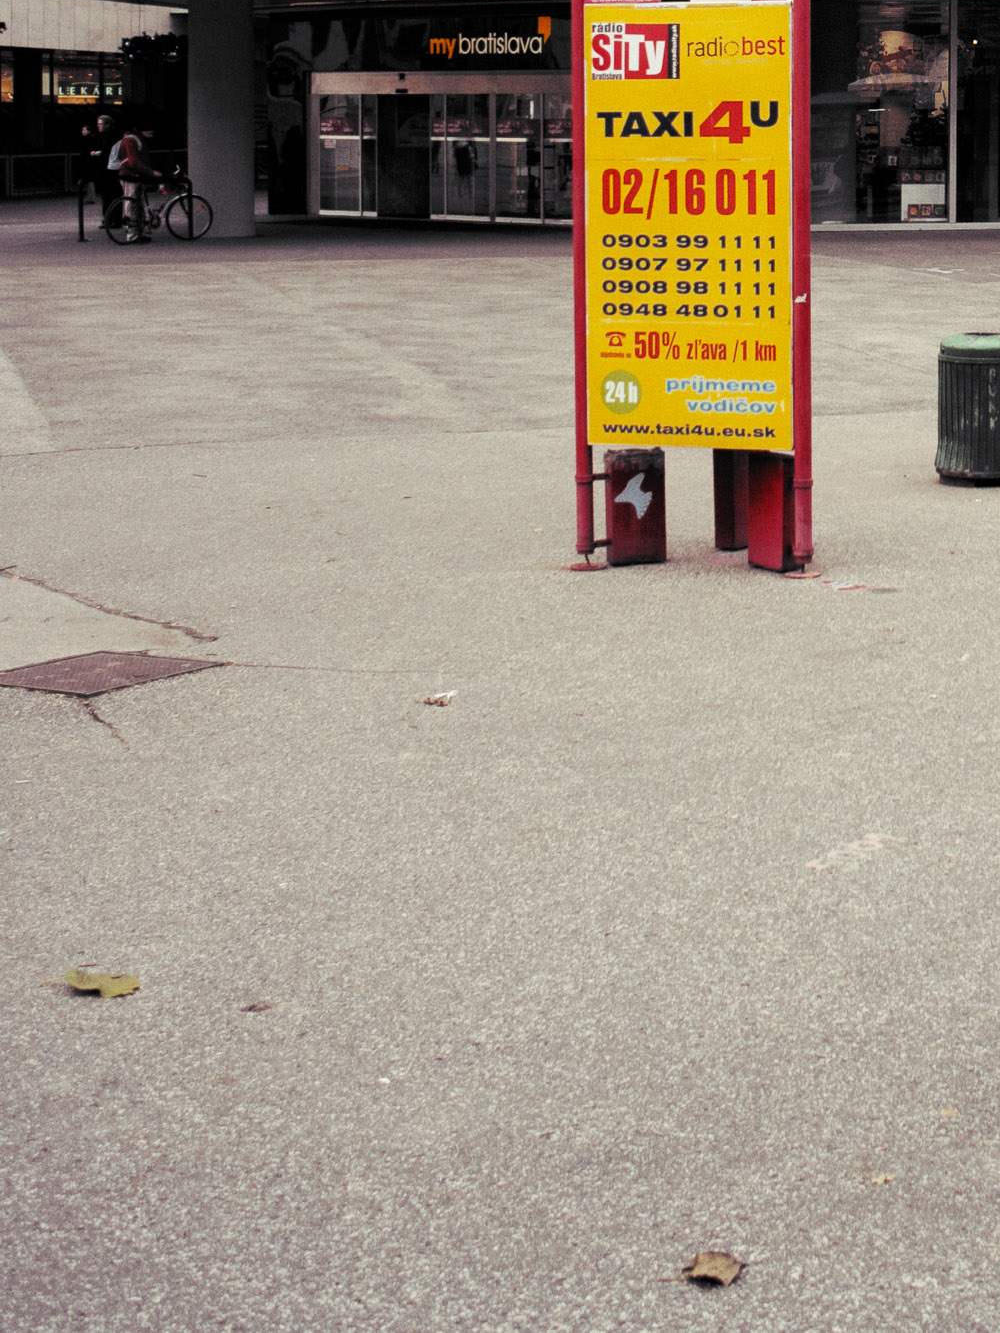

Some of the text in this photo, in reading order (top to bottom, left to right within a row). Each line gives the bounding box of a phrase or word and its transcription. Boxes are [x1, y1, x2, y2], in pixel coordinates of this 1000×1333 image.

[430, 32, 542, 59] my bratislava
[602, 168, 775, 220] 02/16 011
[602, 234, 667, 248] 0903
[676, 235, 708, 248] 99
[602, 257, 668, 271] 0907
[676, 258, 709, 271] 97
[602, 280, 667, 294] 0908
[676, 281, 708, 294] 98
[602, 303, 667, 316] 0948
[676, 304, 708, 317] 48
[634, 331, 680, 360] 50%
[687, 339, 727, 360] zľava
[755, 340, 776, 361] km
[605, 381, 625, 403] 24
[687, 398, 776, 413] vodičov
[603, 423, 776, 438] www.taxi4u.eu.sk
